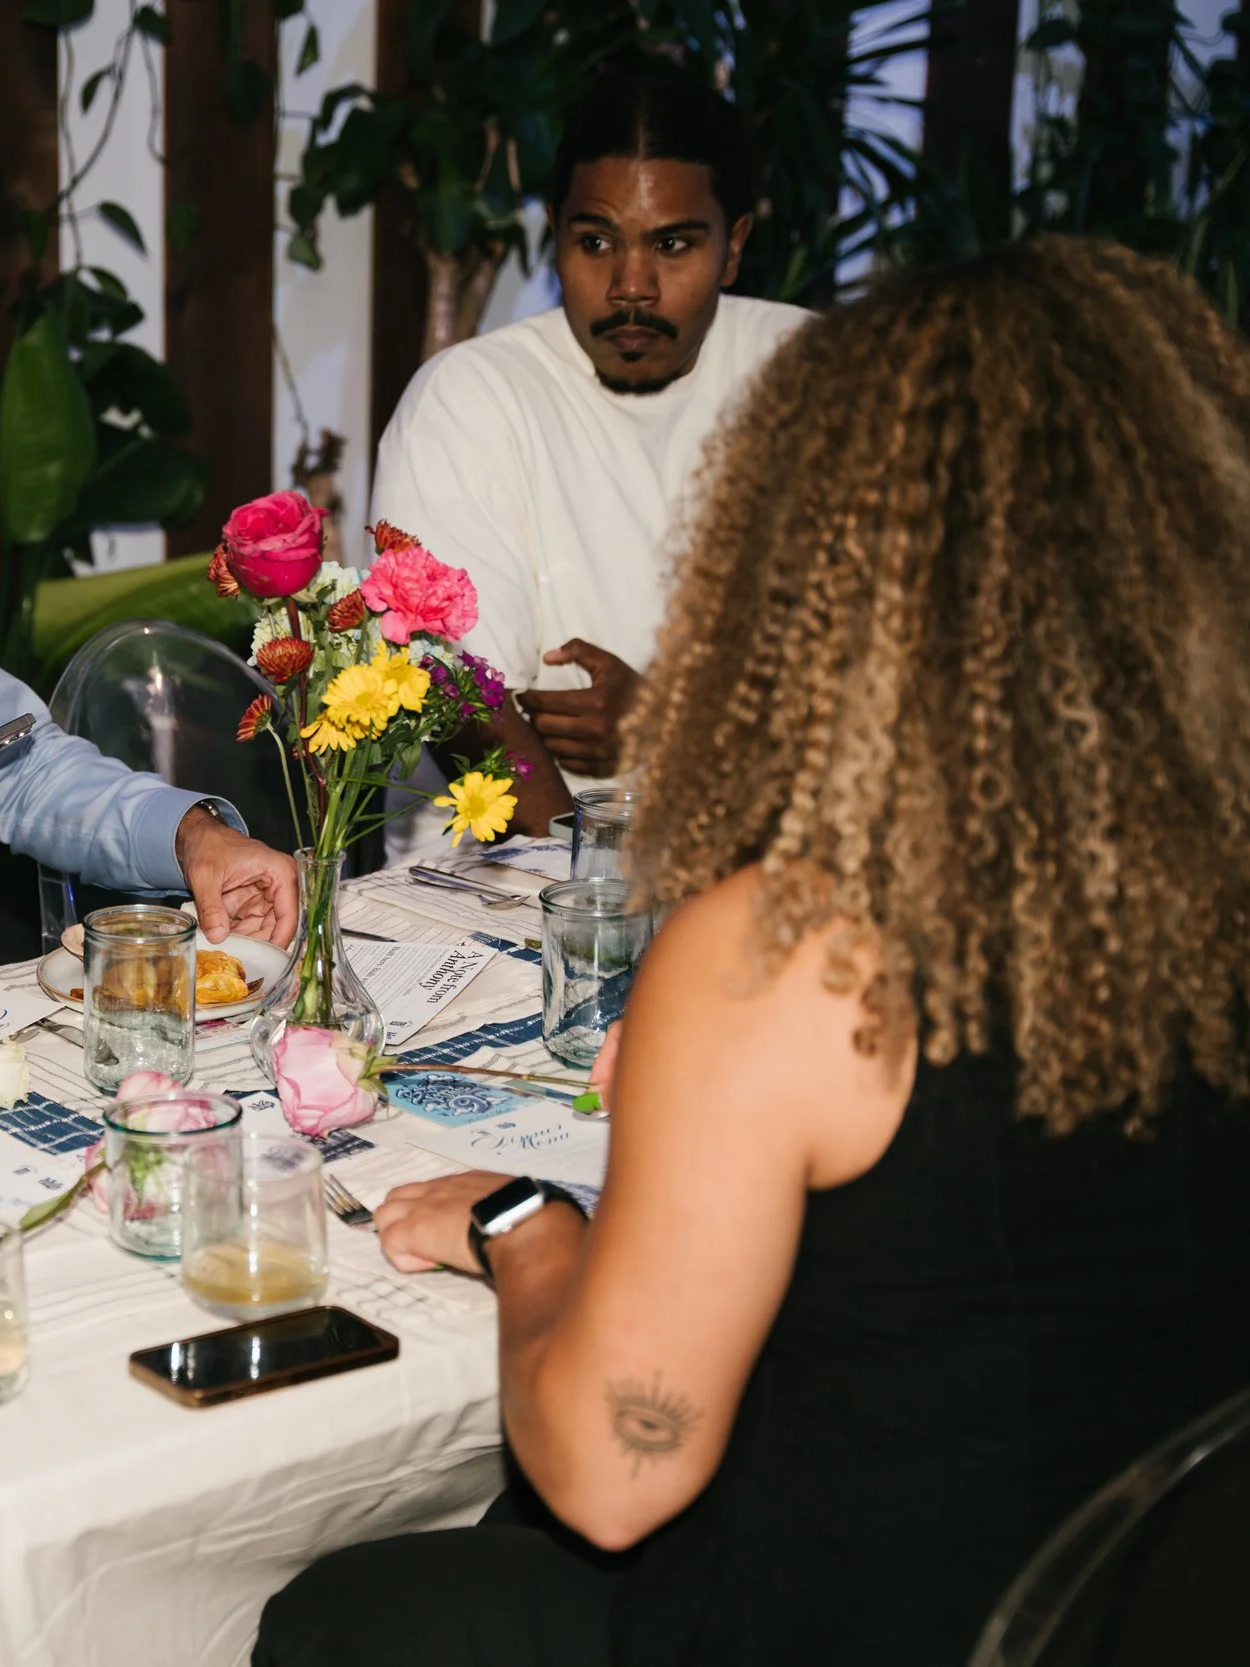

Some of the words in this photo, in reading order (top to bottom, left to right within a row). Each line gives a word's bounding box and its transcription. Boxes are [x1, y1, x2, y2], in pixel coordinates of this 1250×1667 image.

[466, 950, 485, 960] A
[419, 949, 467, 991] Anthony
[447, 962, 479, 983] Note
[426, 983, 458, 1004] from
